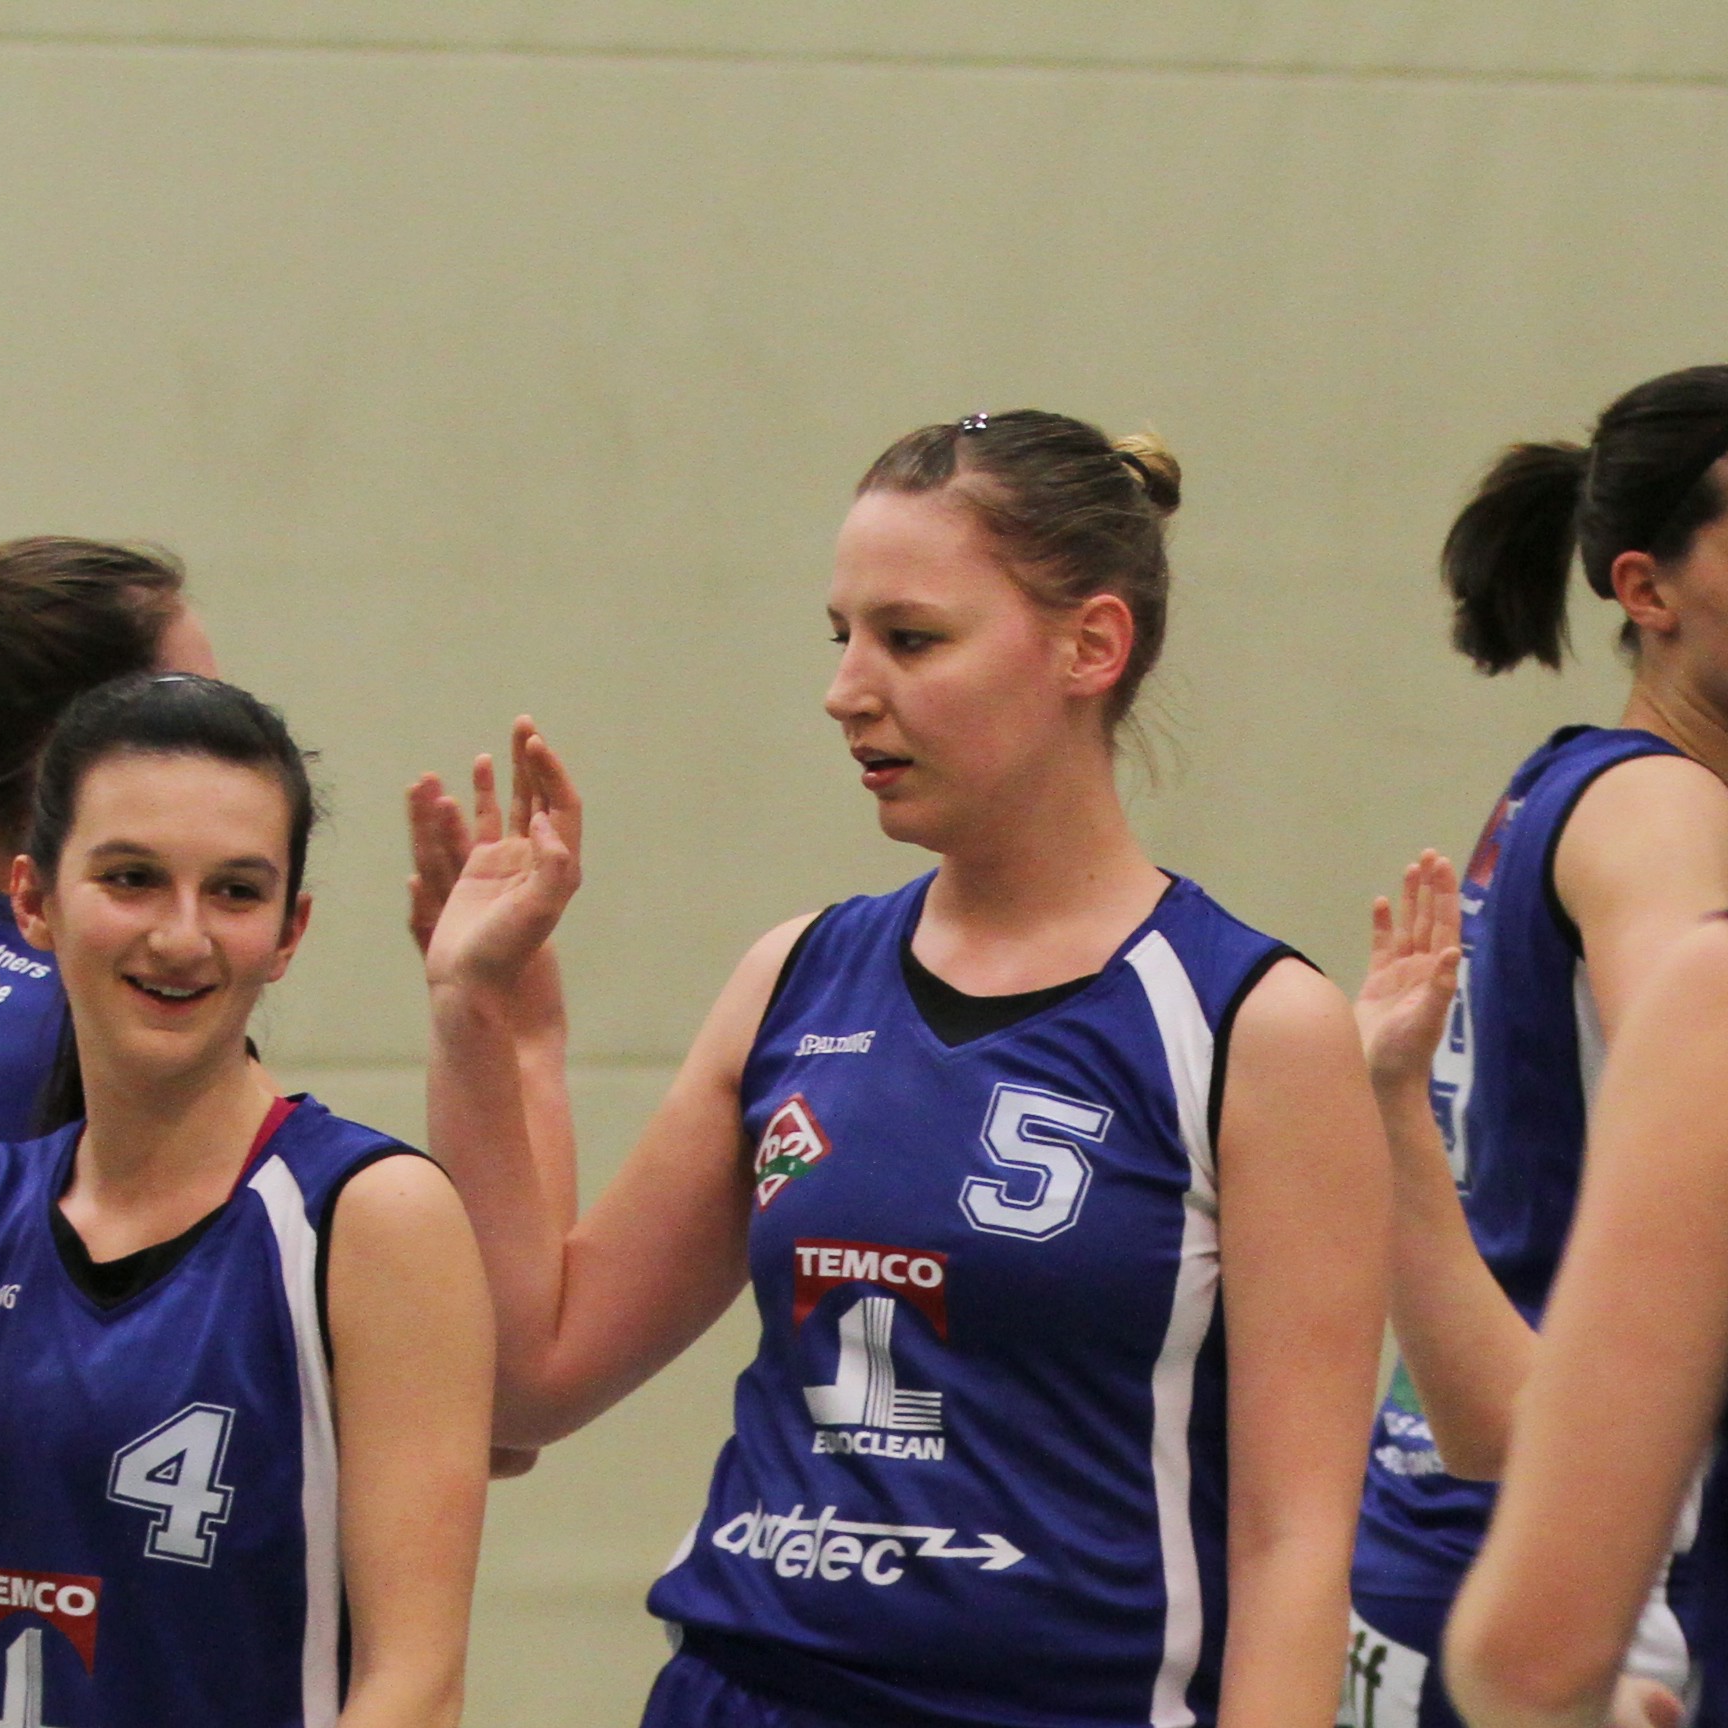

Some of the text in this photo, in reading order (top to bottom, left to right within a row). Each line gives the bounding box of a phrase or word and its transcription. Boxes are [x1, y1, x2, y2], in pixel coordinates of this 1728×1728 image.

[795, 1031, 876, 1057] SPALDING
[958, 1082, 1114, 1242] 5
[795, 1245, 944, 1290] TEMCO
[105, 1402, 236, 1569] 4
